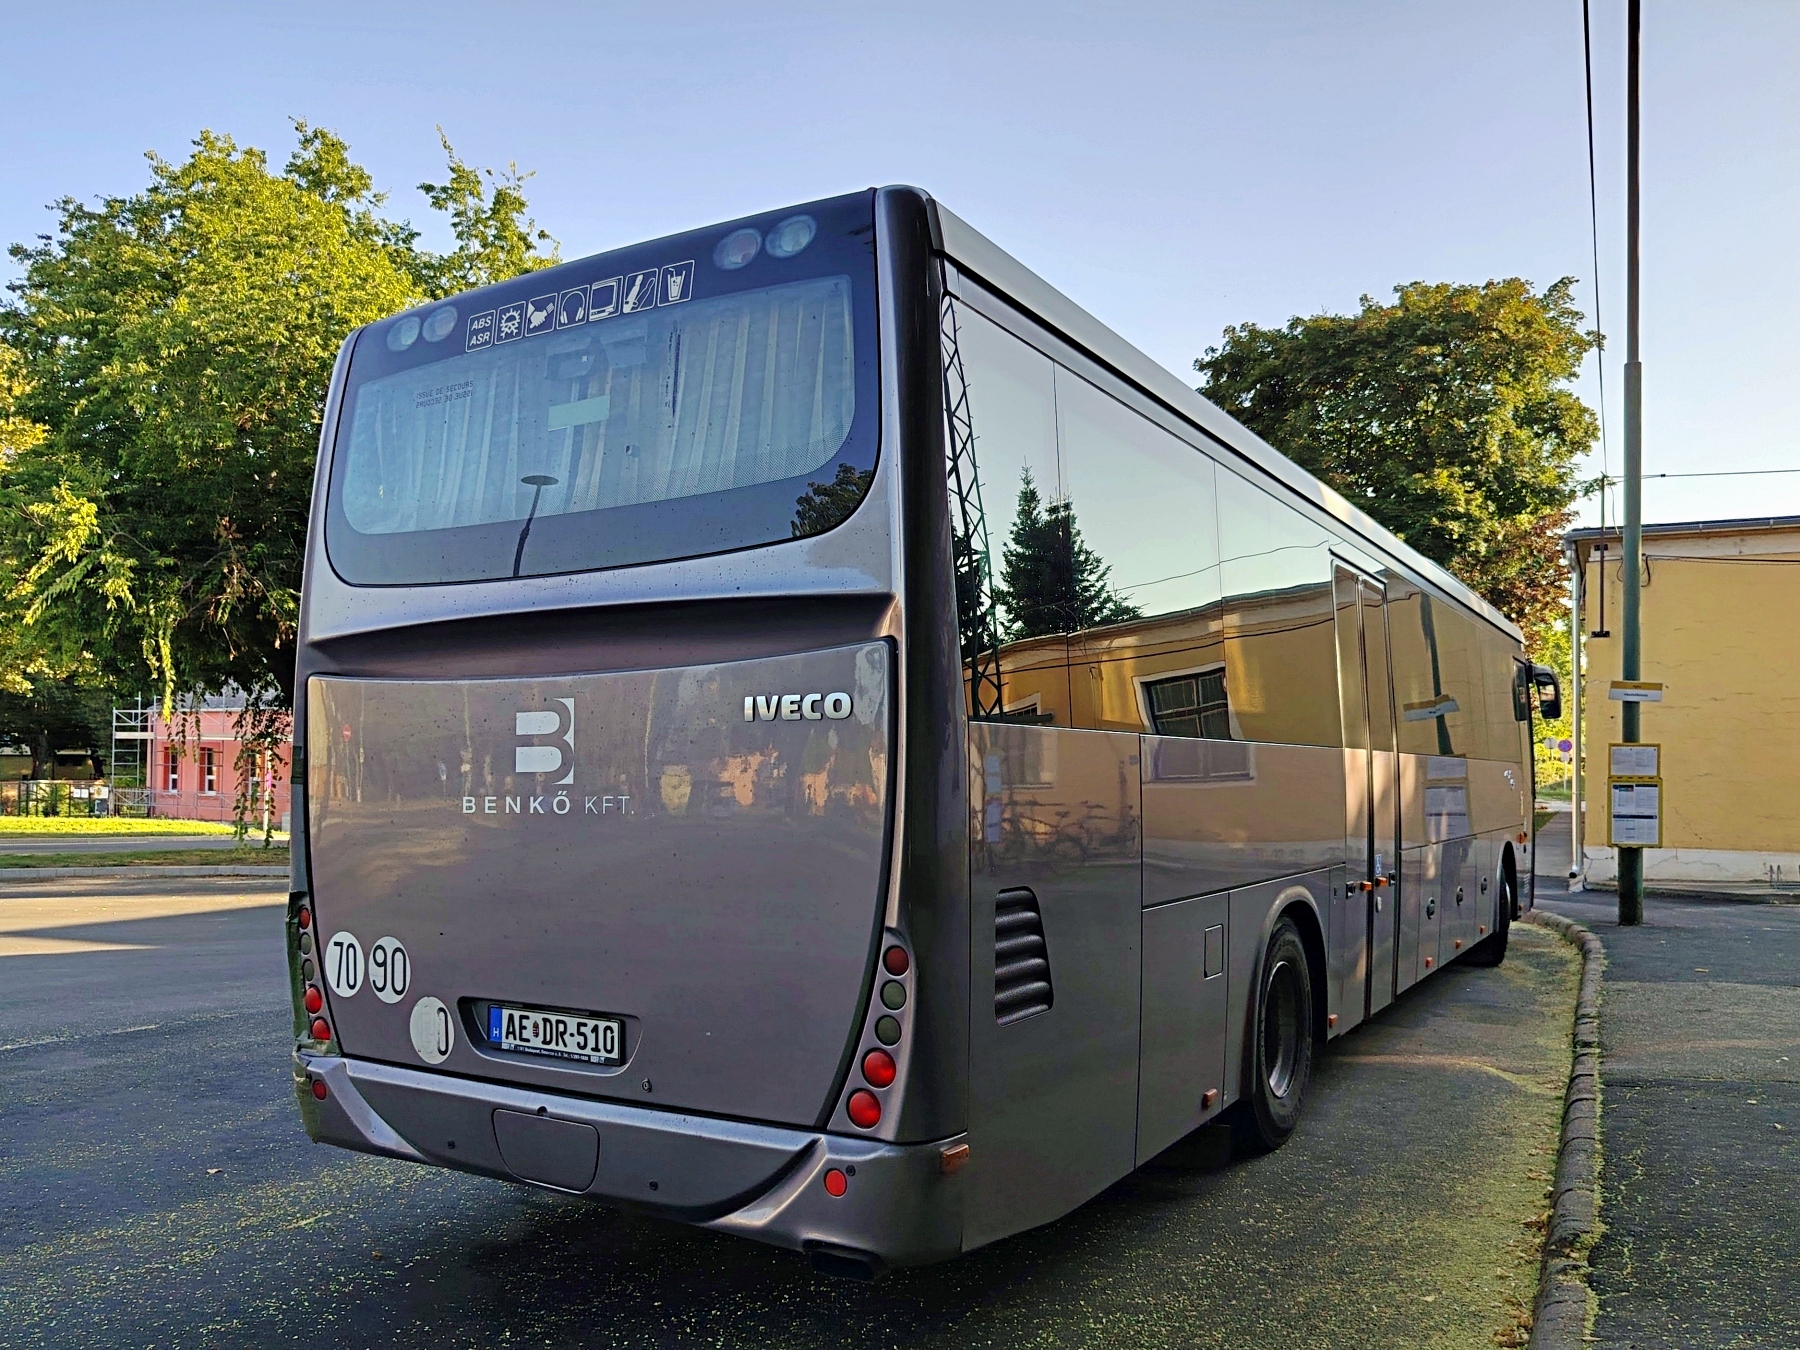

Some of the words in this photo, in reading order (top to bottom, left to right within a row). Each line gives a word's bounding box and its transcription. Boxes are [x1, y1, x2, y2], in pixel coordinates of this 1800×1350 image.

[471, 316, 492, 330] ABS
[469, 332, 490, 346] ASR
[416, 390, 434, 400] ISSUE
[436, 387, 443, 396] DE
[446, 380, 474, 393] SECOURS
[744, 692, 853, 722] IVECO
[462, 790, 571, 815] BENKŐ
[585, 796, 635, 815] KFT.
[333, 941, 357, 990] 70
[372, 944, 407, 996] 90
[493, 1027, 500, 1037] H
[505, 1013, 531, 1043] AE
